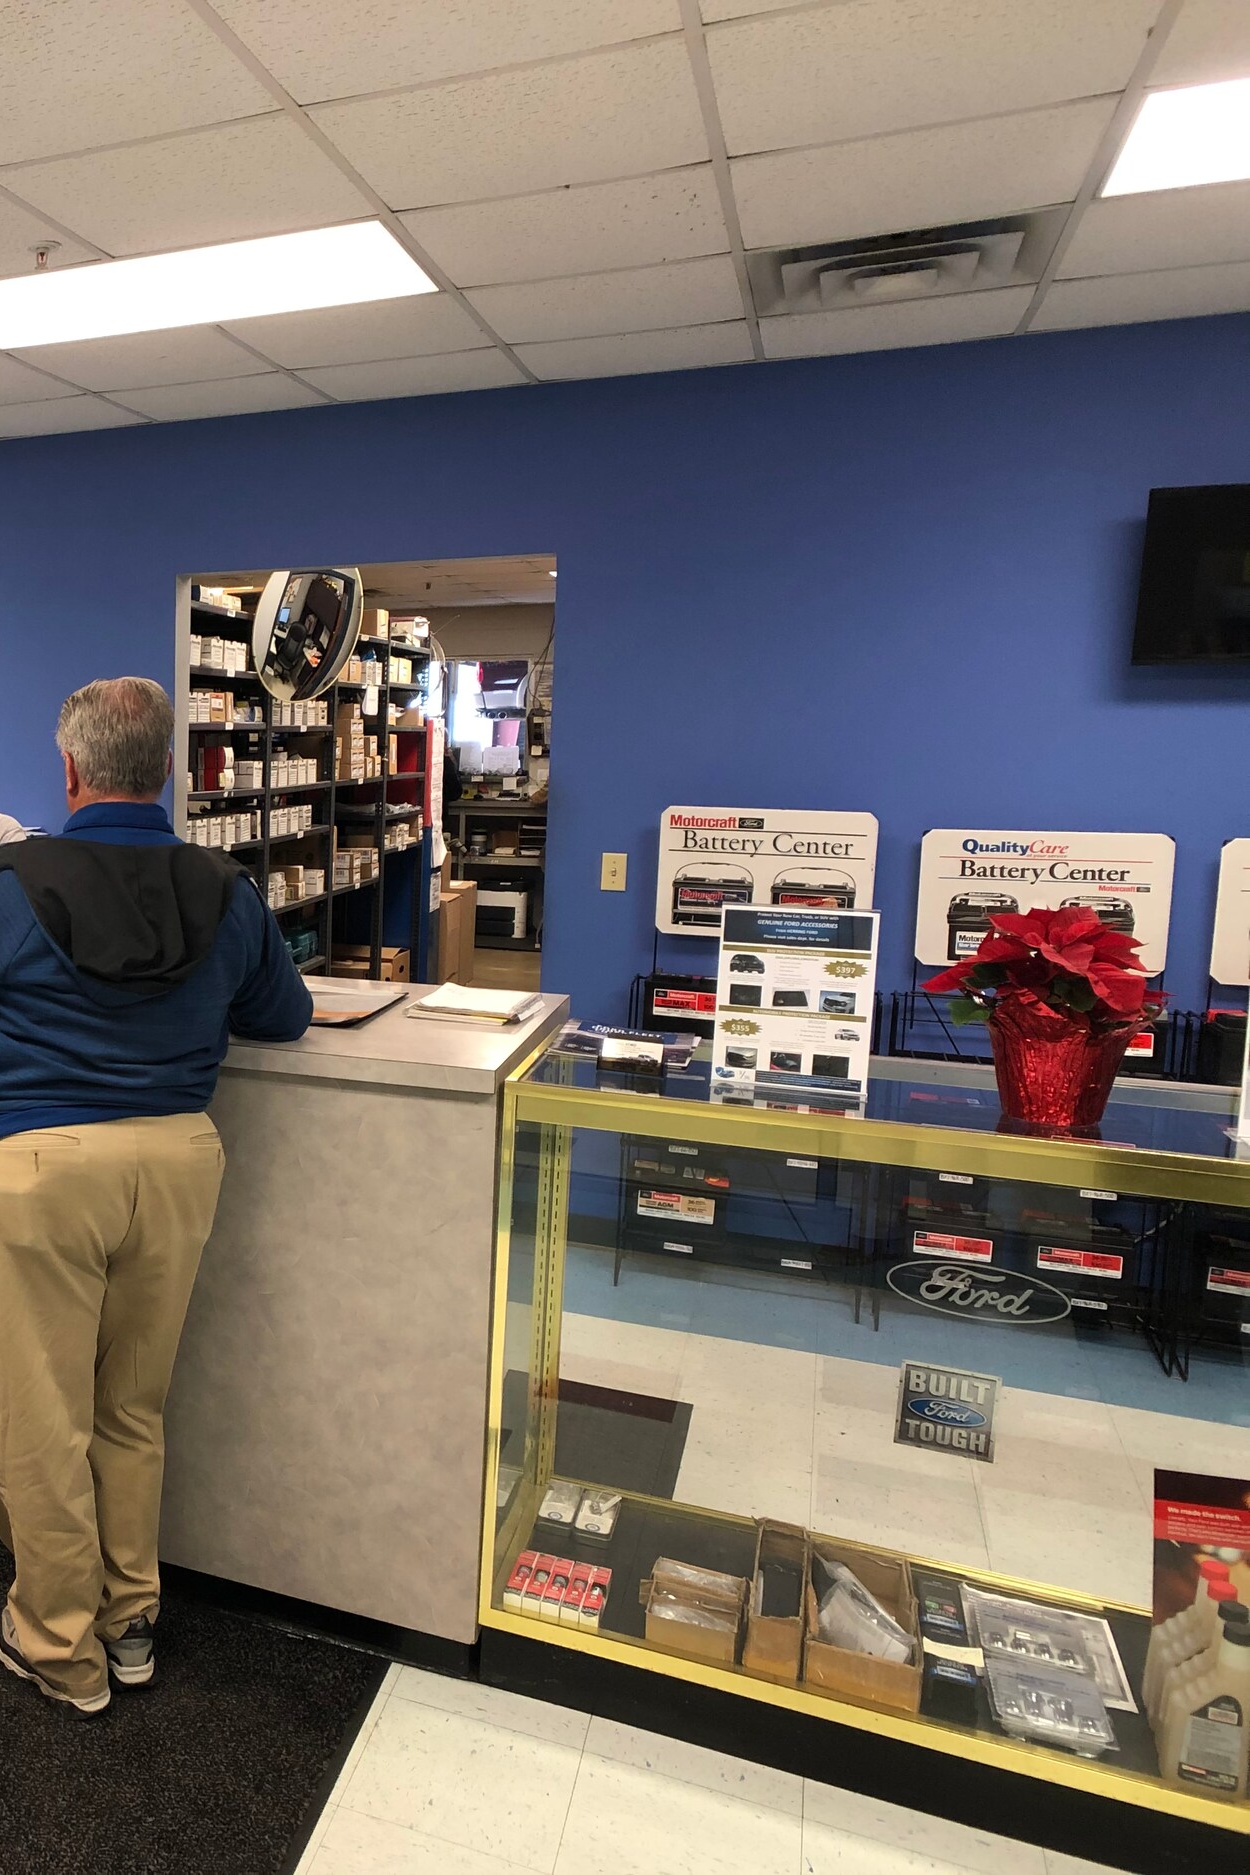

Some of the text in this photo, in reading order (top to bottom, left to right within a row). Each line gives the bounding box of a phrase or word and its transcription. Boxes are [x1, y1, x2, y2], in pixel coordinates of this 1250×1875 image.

[670, 814, 737, 828] Motorcraft
[683, 830, 854, 857] Battery Center
[959, 860, 1130, 885] Battery Center
[958, 934, 985, 942] Motorc
[836, 966, 856, 974] $397
[731, 1024, 750, 1032] $355
[919, 1265, 1034, 1316] Ford
[909, 1369, 991, 1405] BUILT
[924, 1401, 971, 1422] Ford
[905, 1418, 986, 1453] TOUGH
